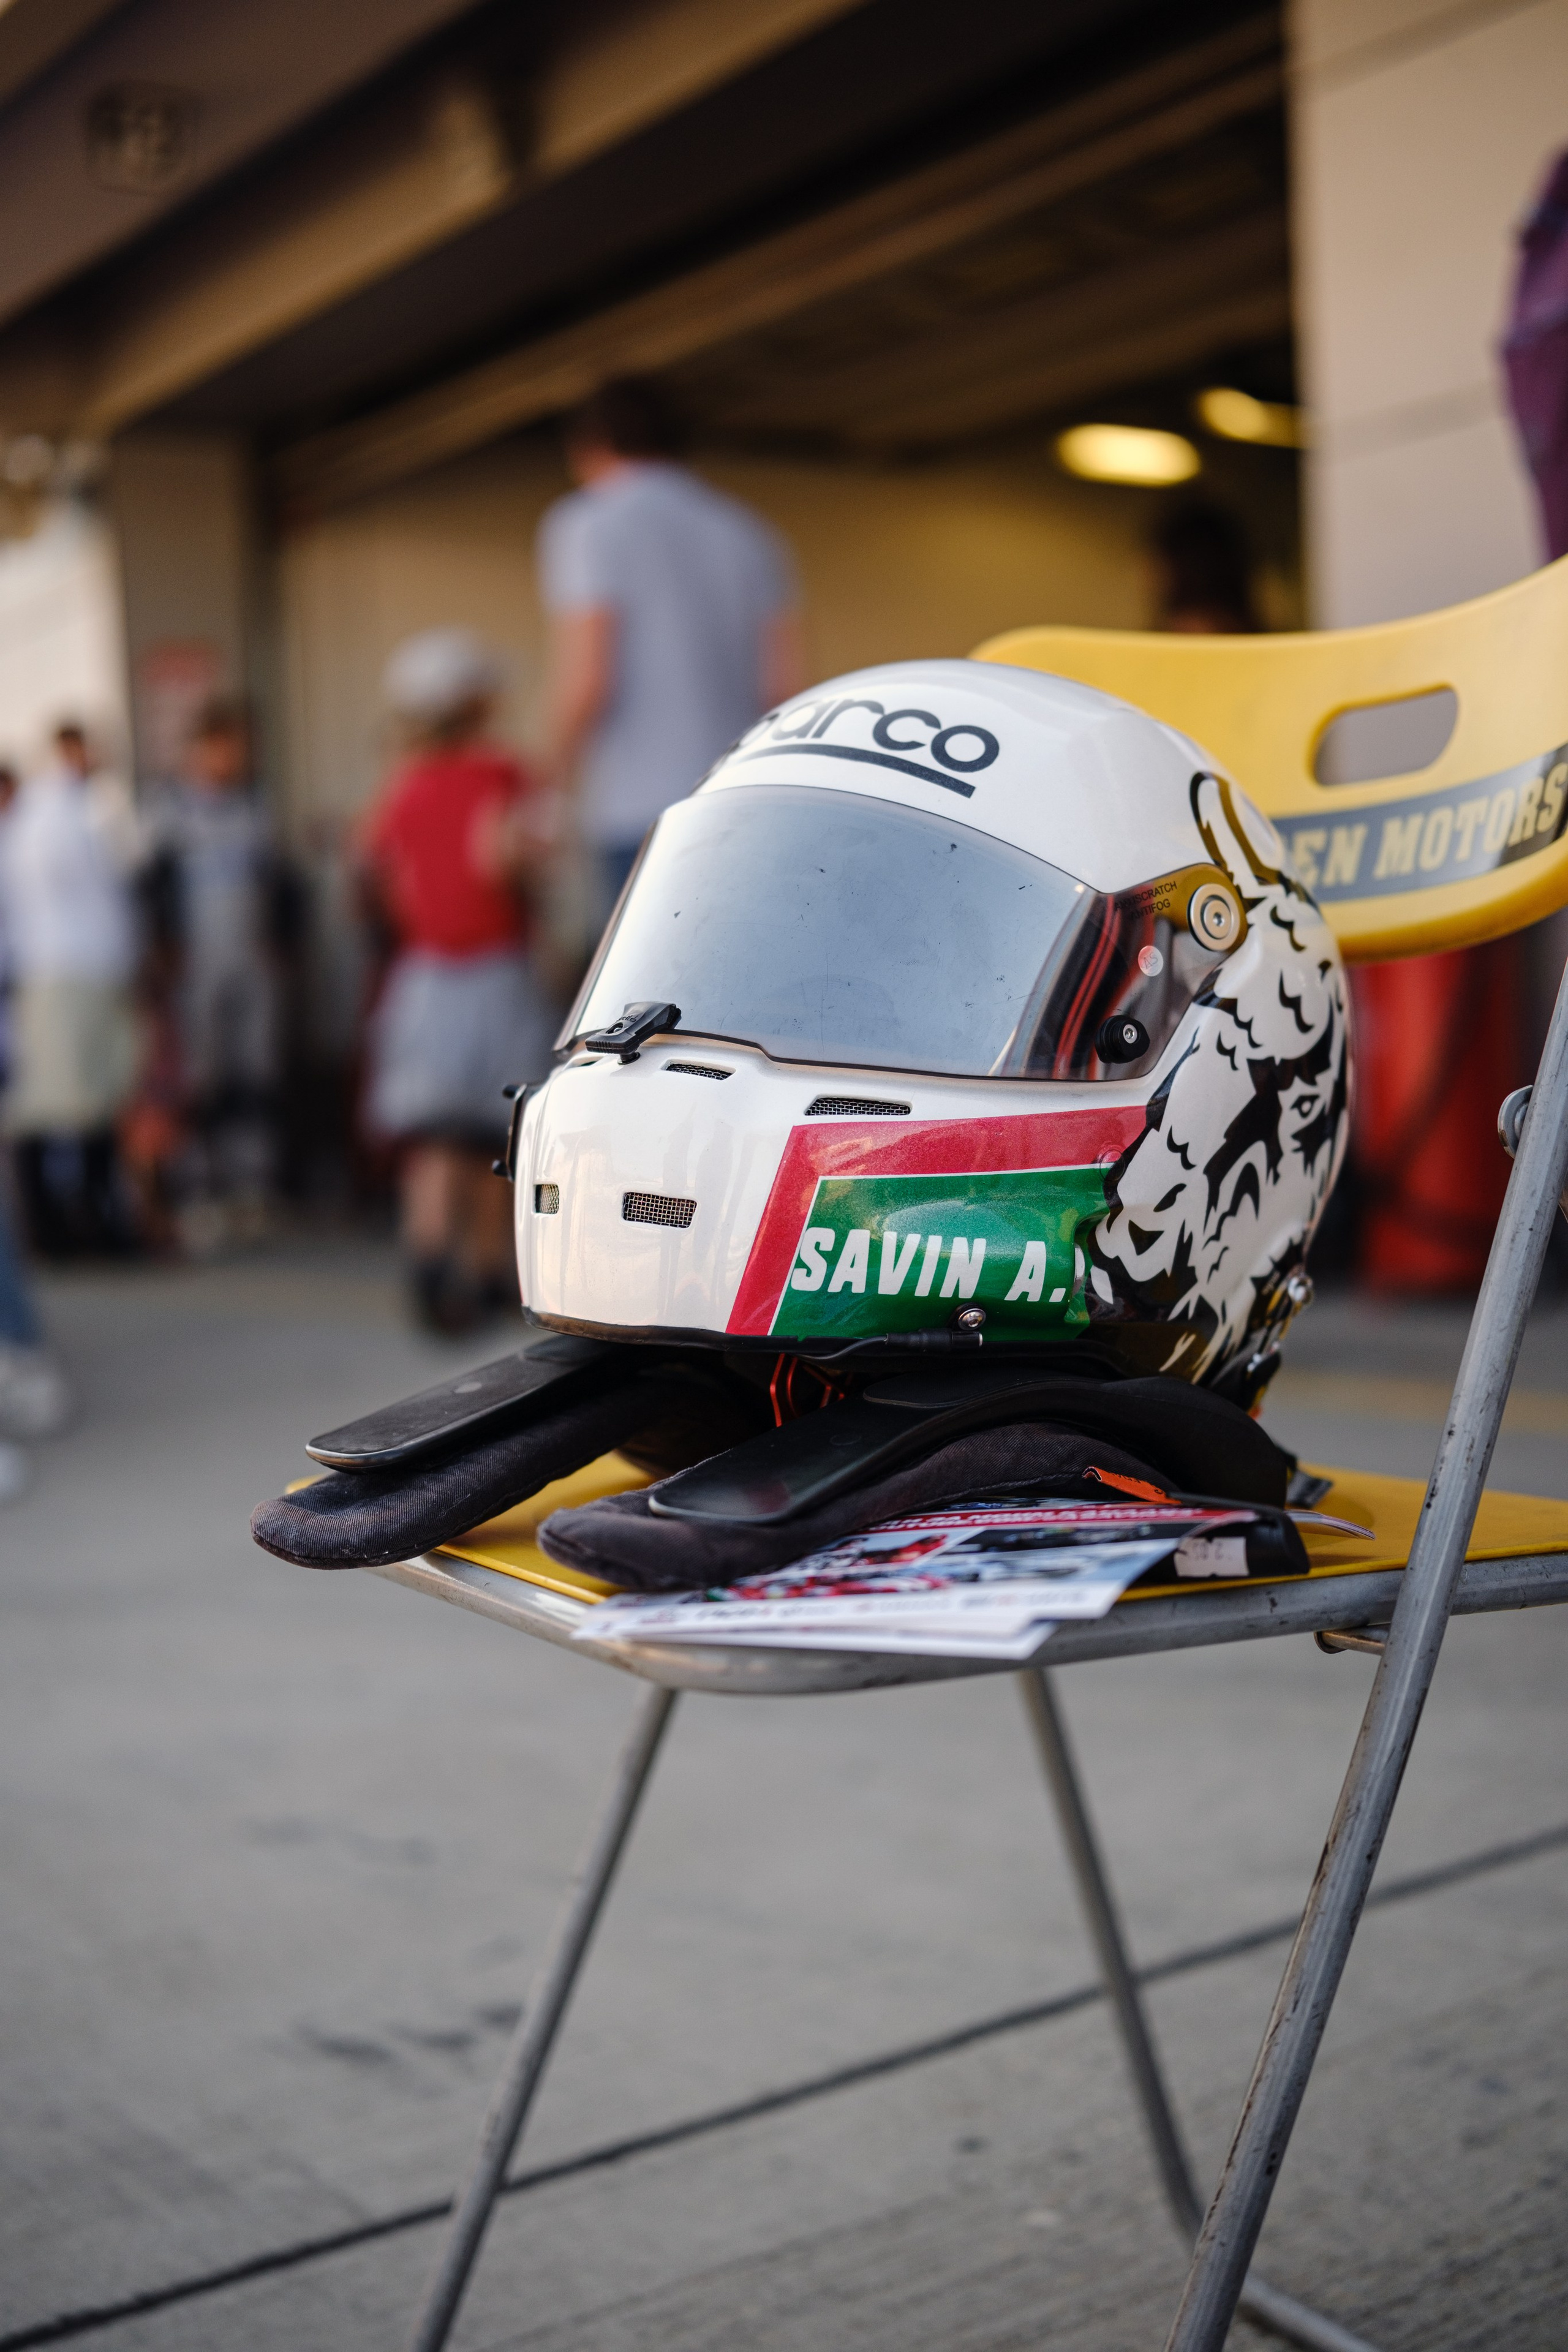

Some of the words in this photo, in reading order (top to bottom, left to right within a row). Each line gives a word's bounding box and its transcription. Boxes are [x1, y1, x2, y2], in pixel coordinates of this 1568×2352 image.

[1373, 762, 1568, 880] MOTORS
[1115, 881, 1177, 910] ANTISCRATCH
[1131, 899, 1170, 919] ANTIFOG
[791, 1227, 986, 1298] SAVIN
[1005, 1241, 1066, 1302] A.
